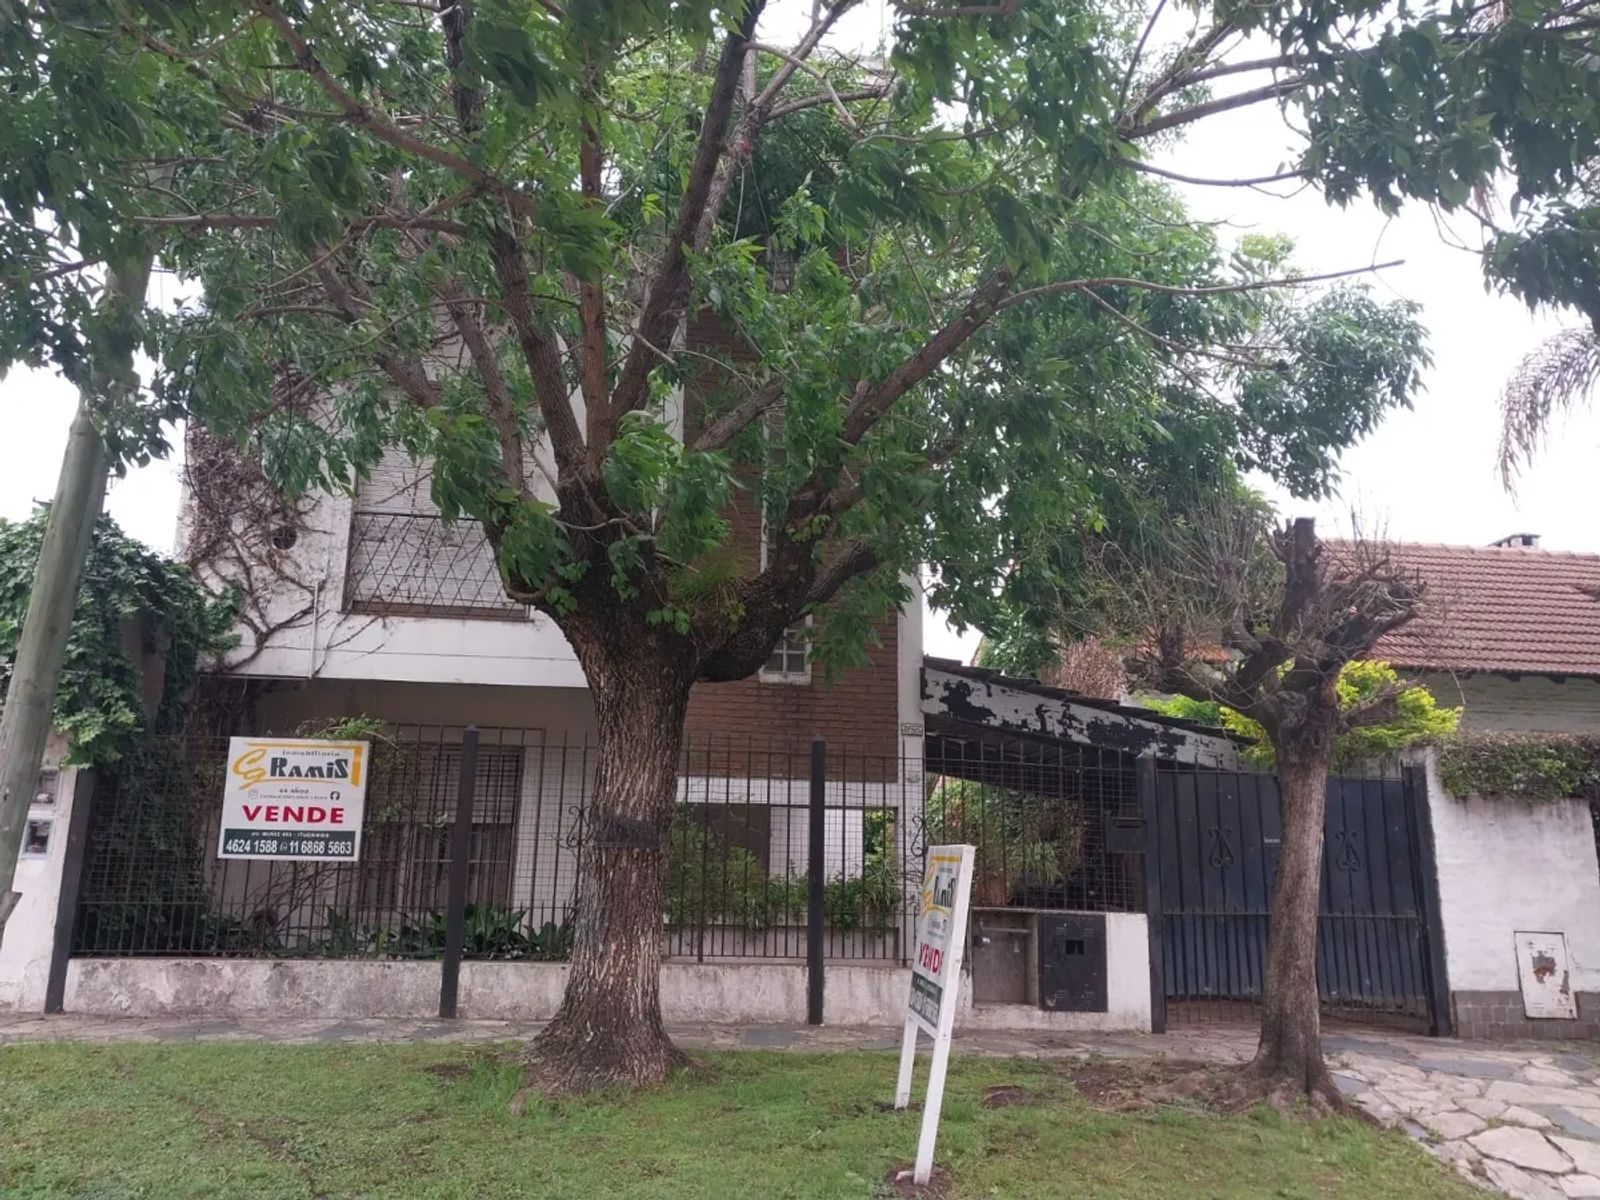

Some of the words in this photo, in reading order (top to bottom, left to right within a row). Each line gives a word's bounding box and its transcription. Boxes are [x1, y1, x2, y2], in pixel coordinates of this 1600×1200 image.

[242, 805, 345, 824] VENDE
[226, 839, 251, 853] 4624
[289, 840, 299, 854] 11
